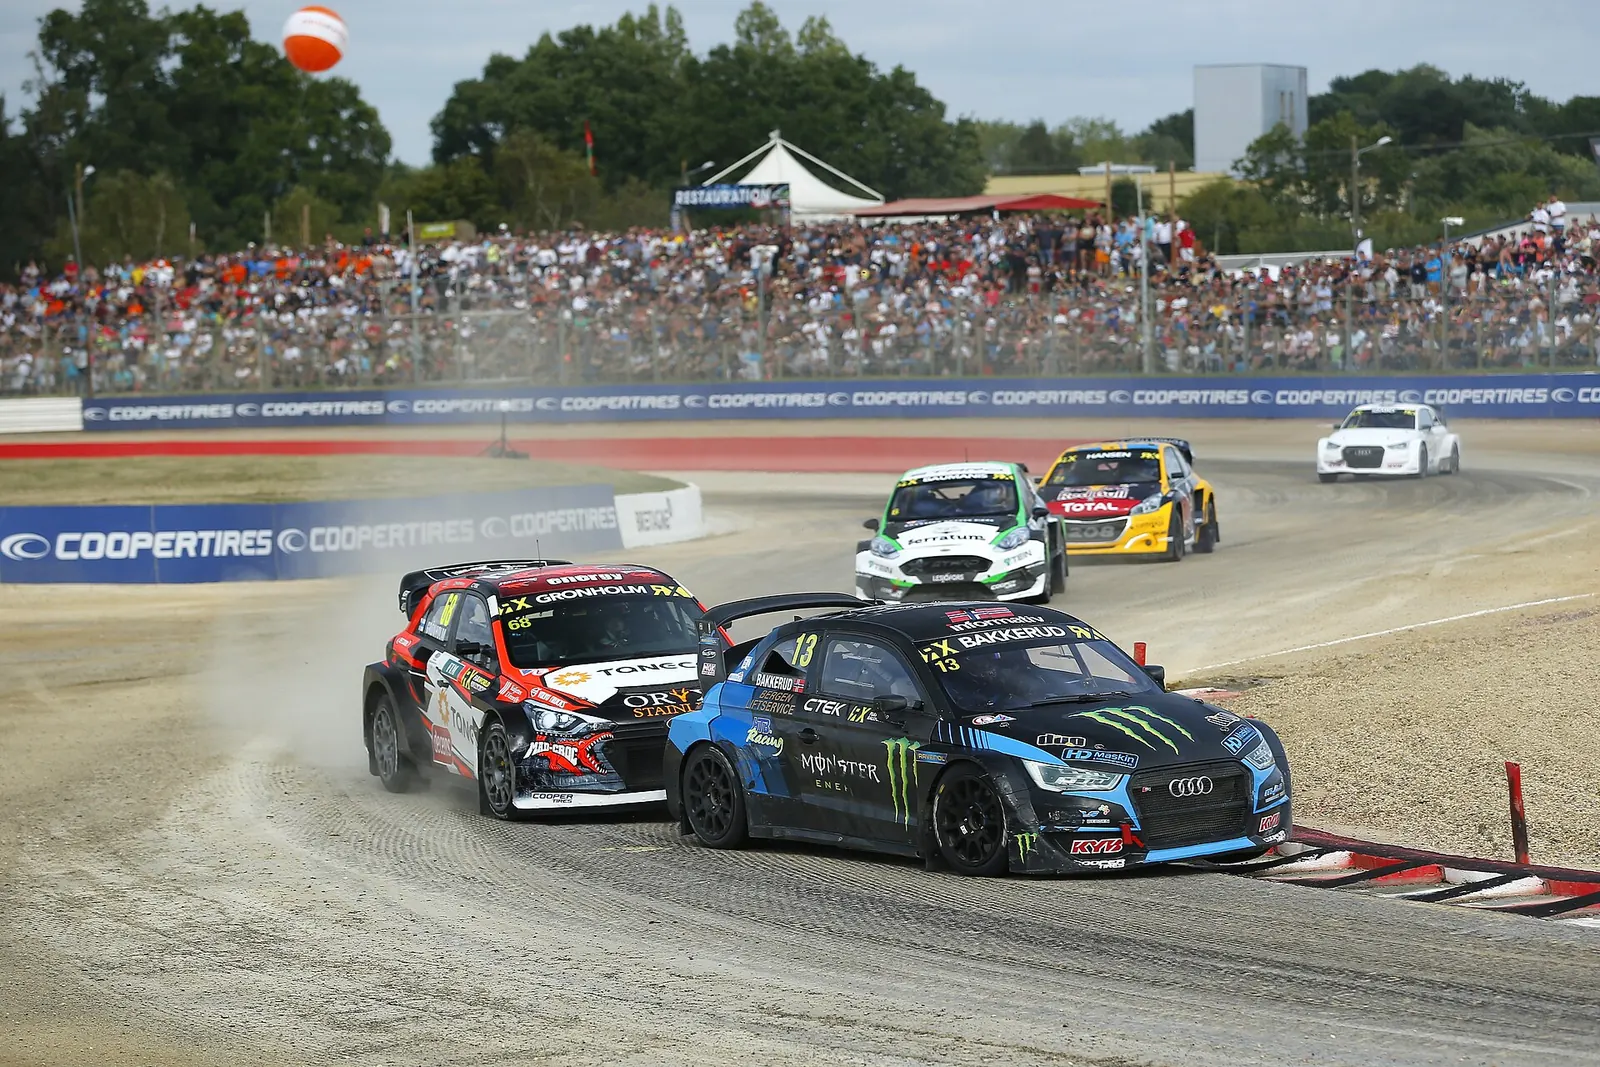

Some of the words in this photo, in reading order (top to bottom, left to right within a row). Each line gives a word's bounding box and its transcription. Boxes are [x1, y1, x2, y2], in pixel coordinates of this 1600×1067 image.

[675, 188, 771, 206] RESTAURATION
[1085, 451, 1132, 460] HANSEN
[1061, 502, 1119, 513] TOTAL
[509, 506, 616, 538] COOPERTIRES
[309, 518, 473, 553] COOPERTIRES
[55, 529, 272, 561] COOPERTIRES
[546, 572, 624, 586] energy
[535, 585, 648, 605] GRONHOLM
[507, 616, 532, 631] 68
[946, 614, 1045, 632] informativ
[958, 624, 1066, 650] BAKKERUD
[791, 632, 818, 667] 13
[935, 657, 961, 673] 13
[755, 673, 793, 692] BAKKERUD
[759, 689, 794, 703] BERGEN
[745, 699, 796, 716] LIFTSERVICE
[803, 698, 847, 717] CTEK
[745, 727, 784, 757] Racing
[523, 741, 578, 766] MAD-CROC
[1065, 749, 1093, 760] HD
[1093, 751, 1136, 764] Maskin
[1070, 837, 1124, 855] KYB
